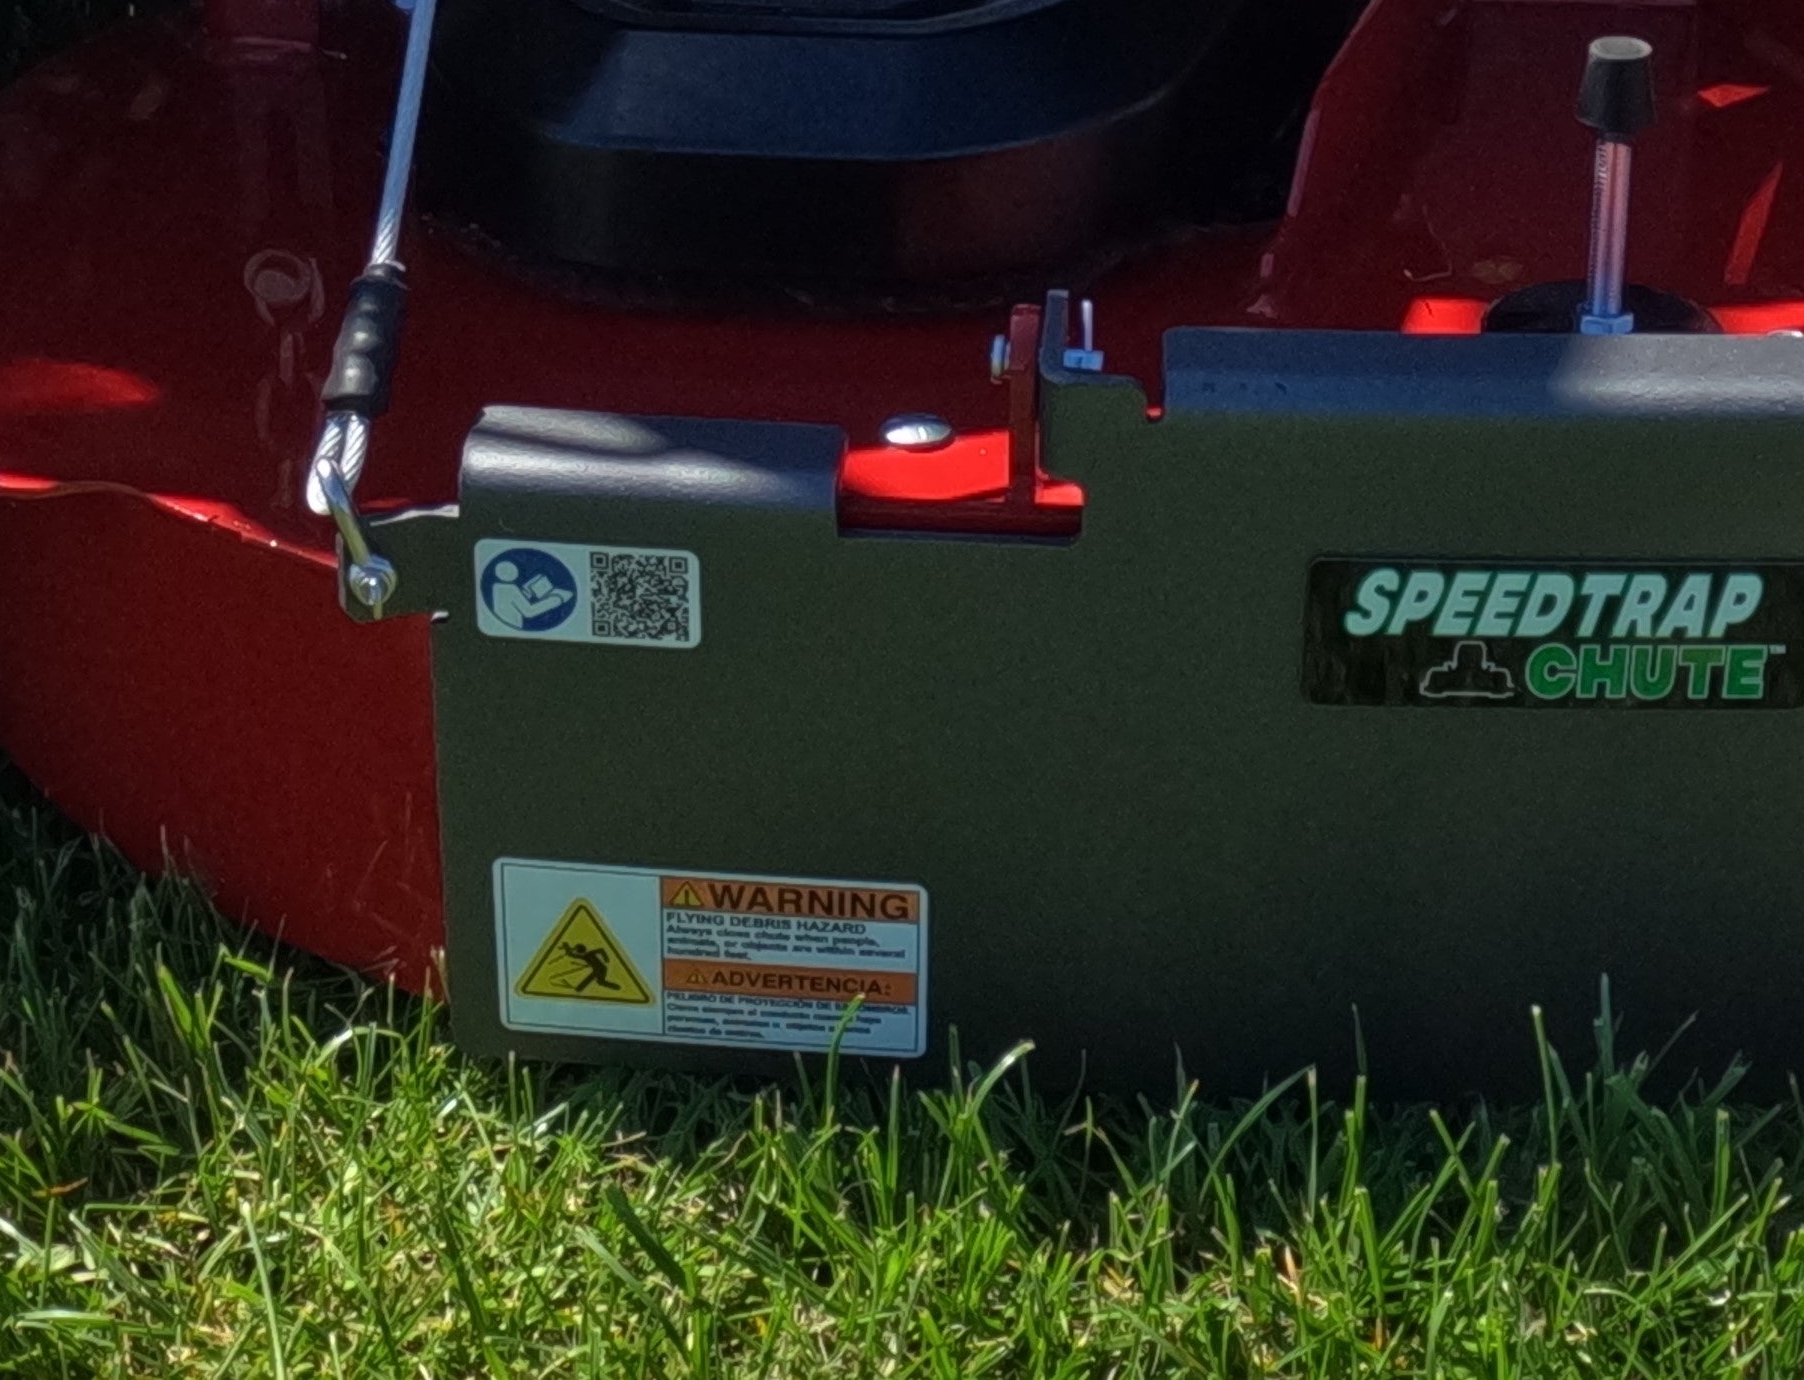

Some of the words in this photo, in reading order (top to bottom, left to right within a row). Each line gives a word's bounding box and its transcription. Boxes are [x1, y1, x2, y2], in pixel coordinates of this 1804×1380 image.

[1343, 568, 1764, 638] SPEEDTRAP
[1525, 642, 1770, 701] CHUTE
[707, 883, 909, 920] WARNING
[666, 912, 725, 926] FLYING
[730, 916, 791, 930] DEBRIS
[796, 921, 867, 935] HAZARD
[711, 970, 892, 997] ADVERTENCIA:
